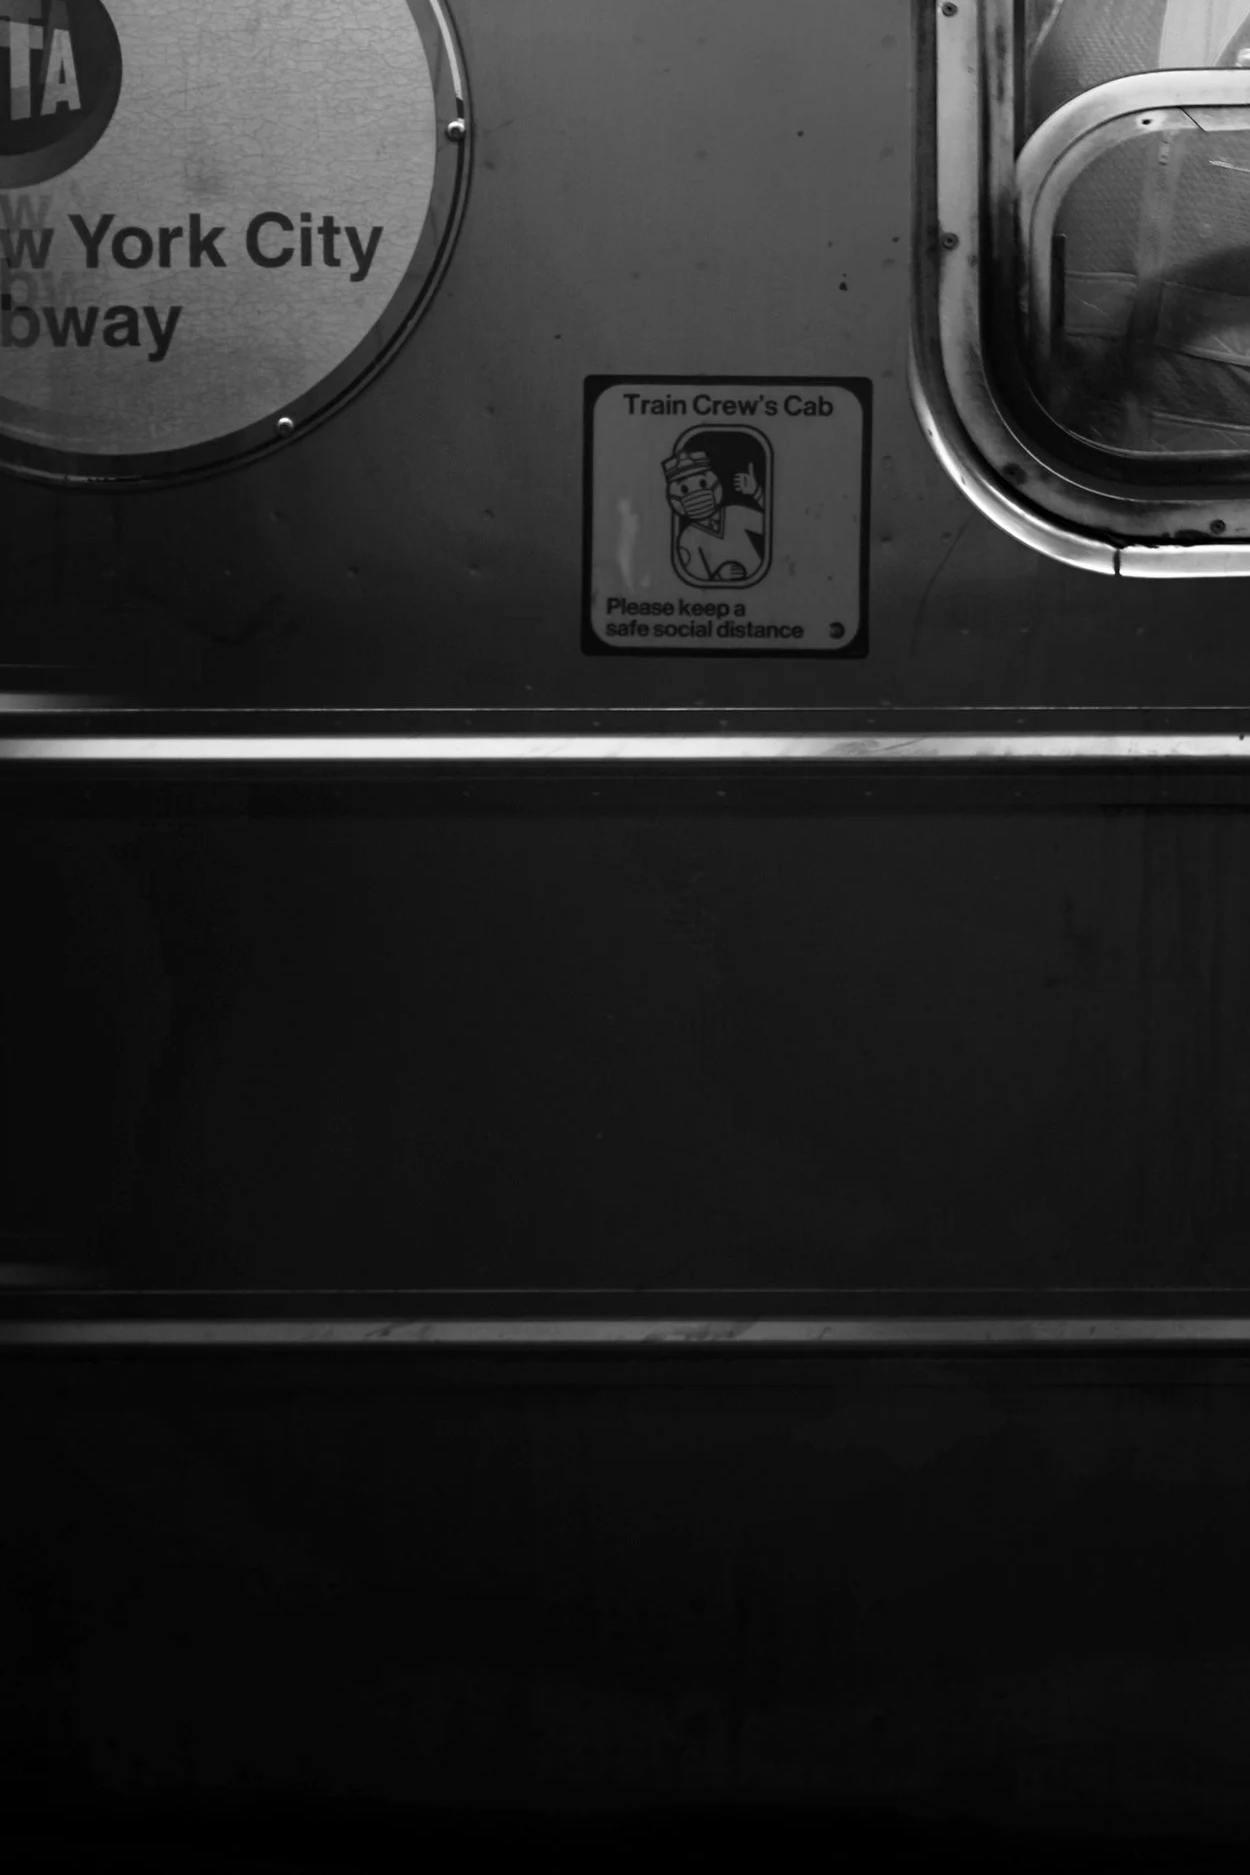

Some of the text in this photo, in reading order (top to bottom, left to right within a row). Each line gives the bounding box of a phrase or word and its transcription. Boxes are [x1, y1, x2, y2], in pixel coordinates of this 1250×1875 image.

[69, 214, 226, 269] York
[245, 211, 384, 282] City
[623, 394, 833, 417] Train Crew's Cab
[607, 597, 745, 619] Please keep a
[606, 619, 804, 639] safe social distance
